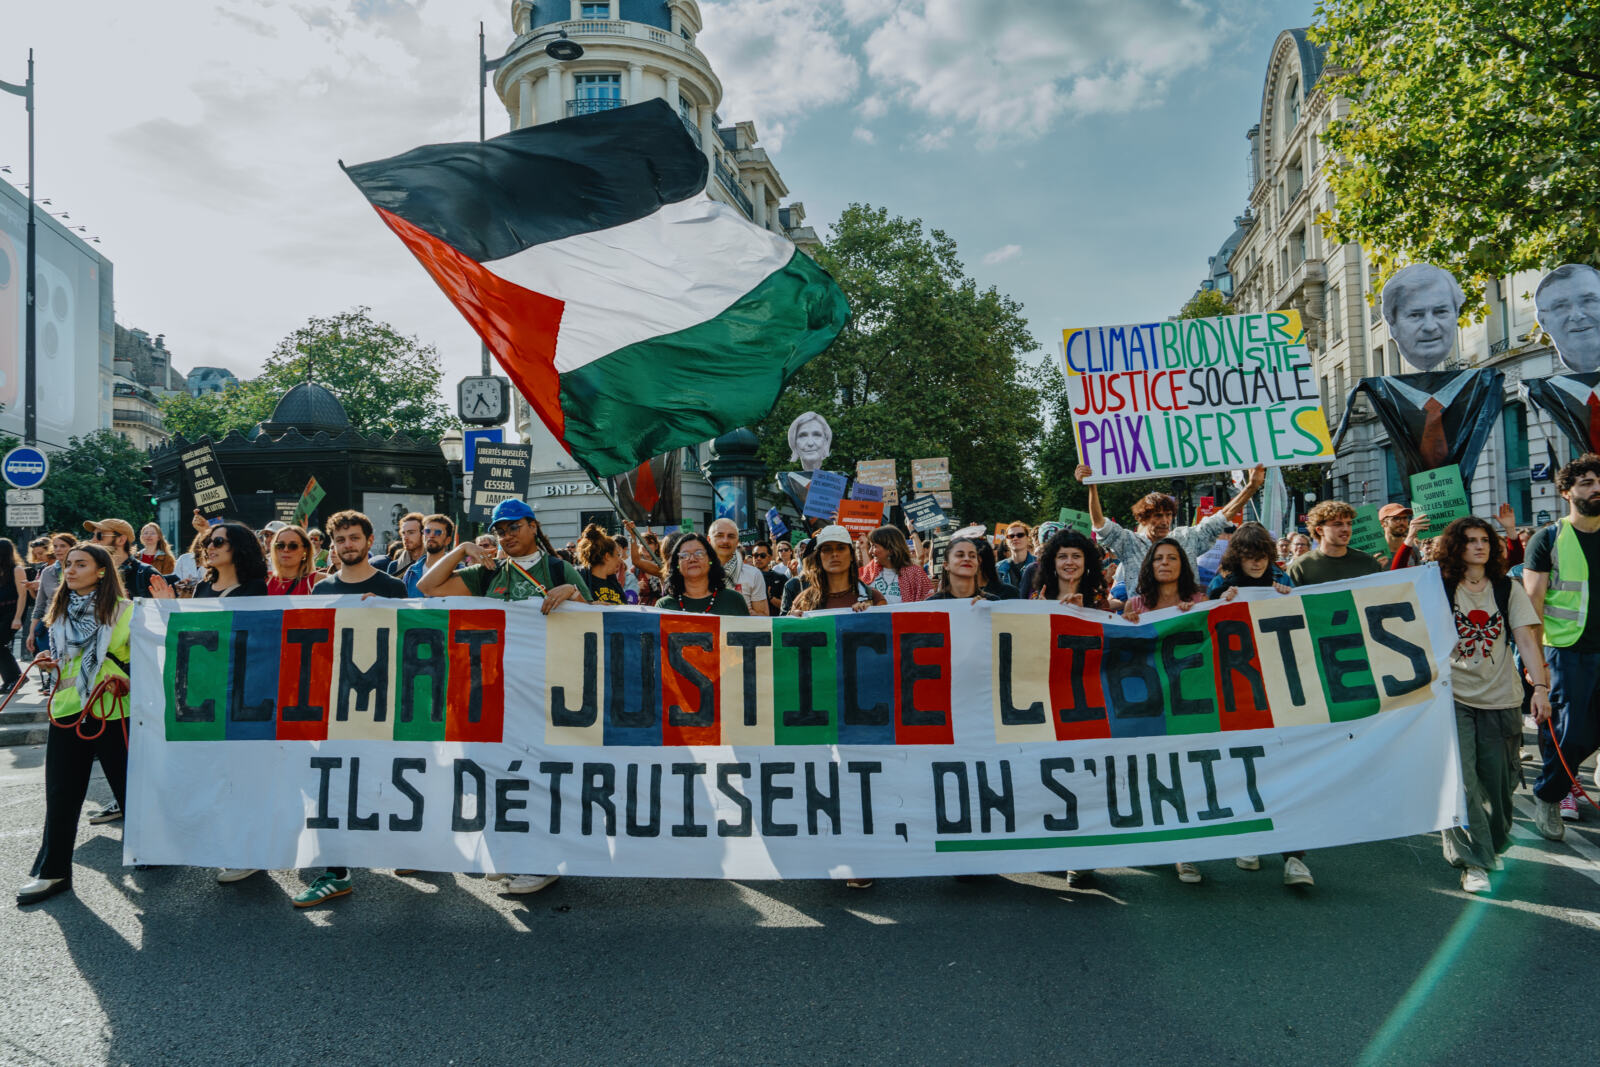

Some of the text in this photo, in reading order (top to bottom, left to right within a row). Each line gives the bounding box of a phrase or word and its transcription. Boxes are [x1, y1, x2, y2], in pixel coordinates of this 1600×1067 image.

[1066, 322, 1161, 373] CLIMAT
[1074, 363, 1319, 415] JUSTICE SOCIALE
[1079, 402, 1324, 476] PAIX LIBERTÉS
[478, 448, 529, 458] LIBERTÉS MUSELÉES,
[478, 457, 507, 466] QUARTIERS
[490, 468, 512, 478] ON NE
[484, 480, 514, 490] CESSERA
[544, 484, 578, 496] BNP
[1416, 478, 1454, 492] POUR NOTRE
[1424, 490, 1446, 500] SURVIE
[1432, 502, 1442, 510] LES
[174, 601, 1432, 728] CLIMAT JUSTICE LIBERTÉS
[306, 757, 426, 832] ILS
[932, 760, 1015, 834] ON
[1040, 746, 1265, 831] S'UNIT
